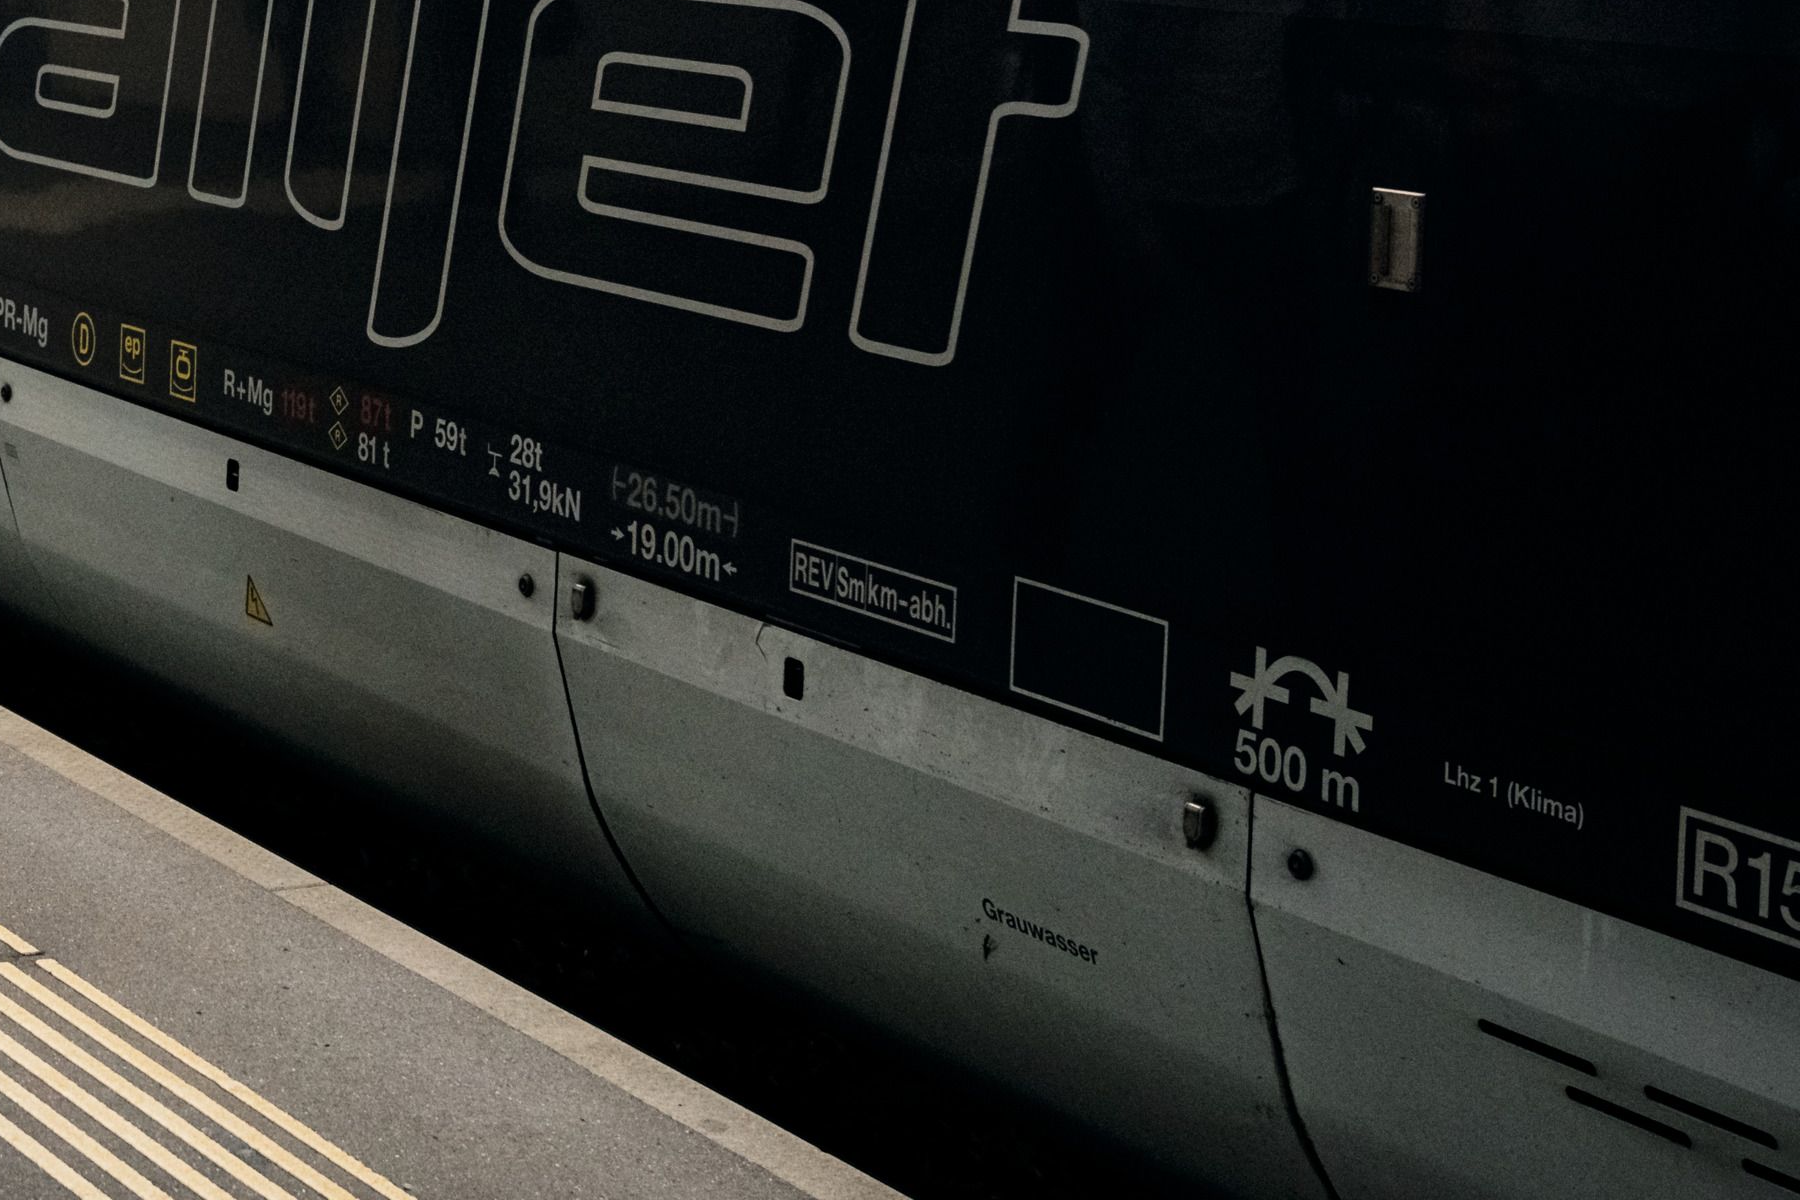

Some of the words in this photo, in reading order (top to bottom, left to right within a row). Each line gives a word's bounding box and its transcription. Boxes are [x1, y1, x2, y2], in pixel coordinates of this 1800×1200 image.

[79, 323, 89, 355] D
[124, 334, 141, 360] ep
[223, 368, 273, 416] R+Mg
[410, 409, 424, 439] P
[434, 417, 468, 457] 59t
[509, 433, 543, 473] 28t
[508, 469, 582, 523] 31,9kN
[627, 519, 721, 582] 19.00m
[794, 551, 834, 592] REV
[1233, 728, 1307, 793] 500
[1321, 766, 1361, 814] m
[1443, 760, 1482, 794] Lhz
[1489, 777, 1498, 798] 1
[1506, 781, 1585, 831] (Klima)
[981, 897, 1099, 965] Grauwasser
